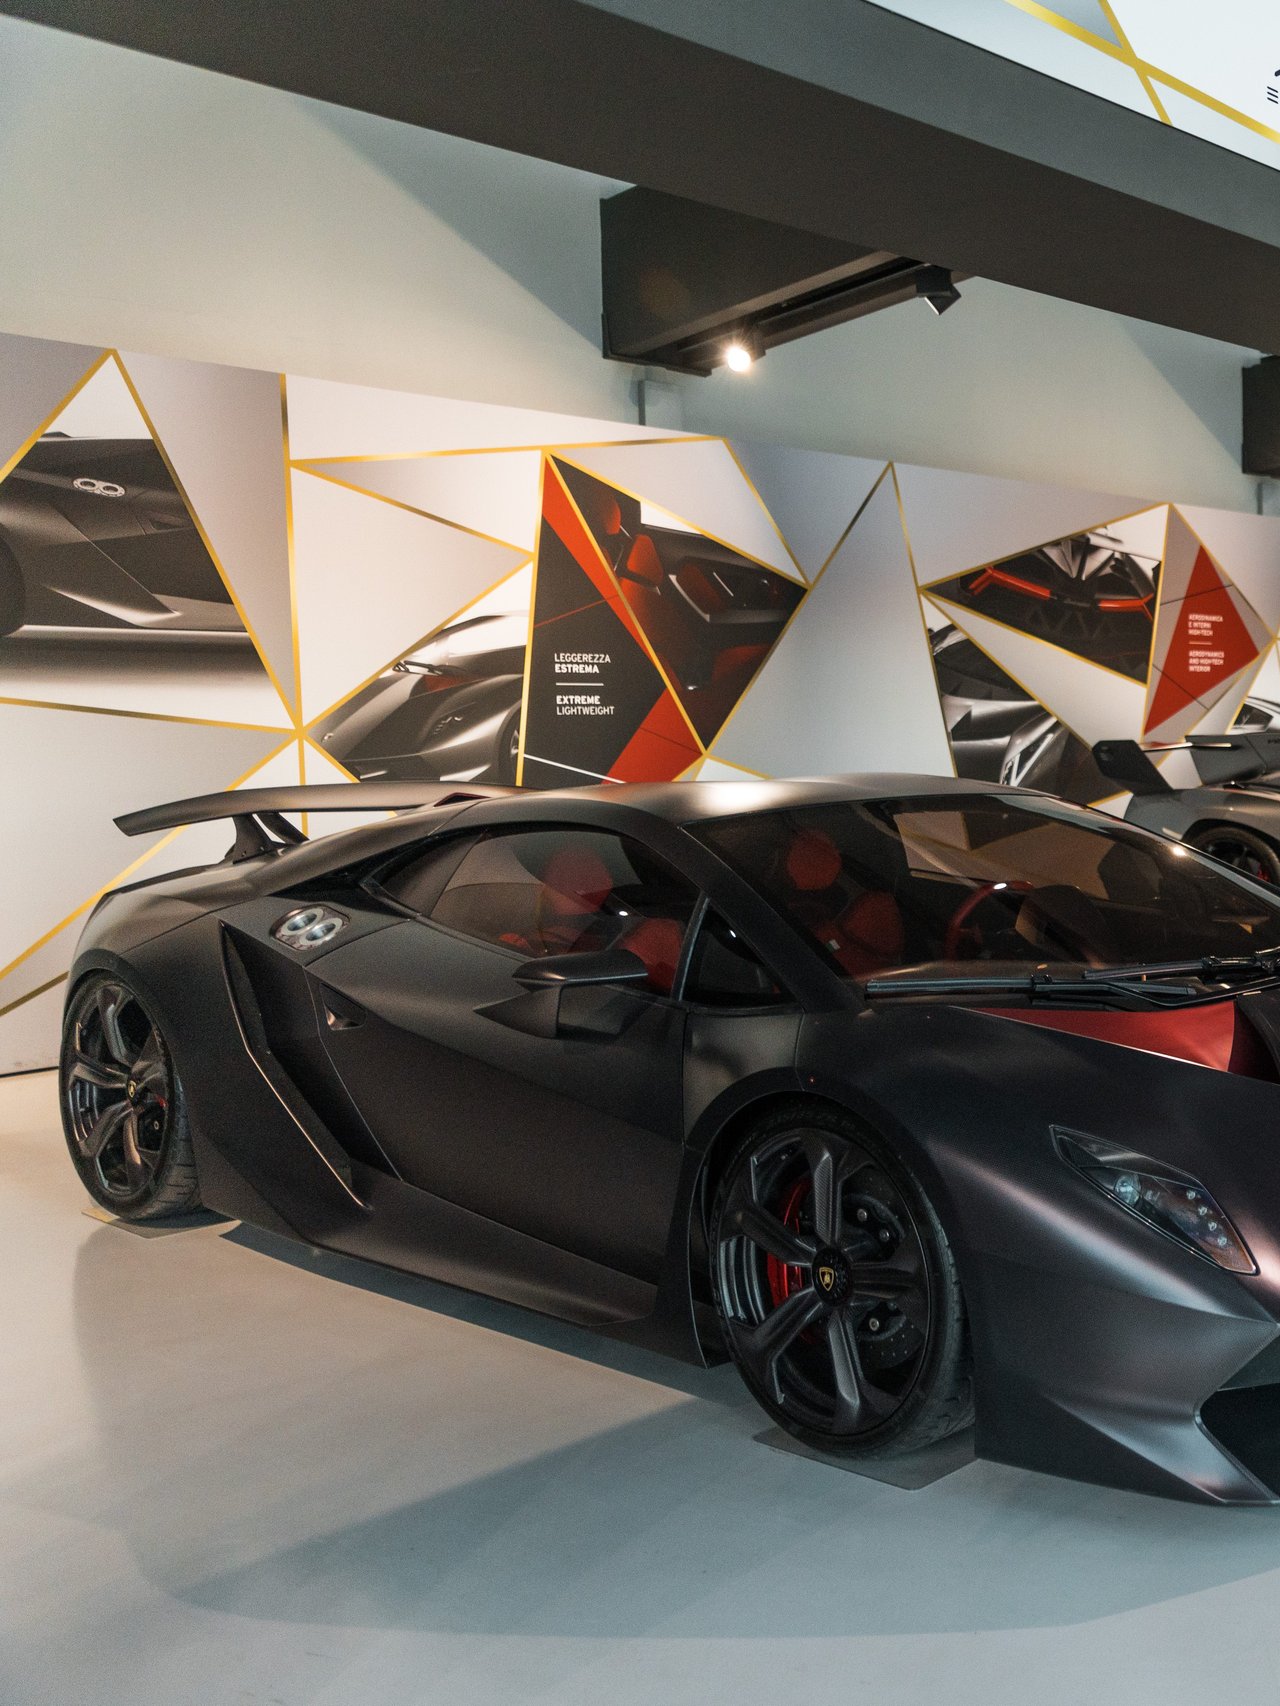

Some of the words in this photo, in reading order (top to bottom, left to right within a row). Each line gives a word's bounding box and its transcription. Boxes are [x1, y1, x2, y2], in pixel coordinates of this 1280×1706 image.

[554, 652, 611, 663] LEGGEREZZA
[554, 663, 600, 673] ESTREMA
[556, 695, 601, 705] EXTREME
[556, 706, 615, 716] LIGHTWEIGHT
